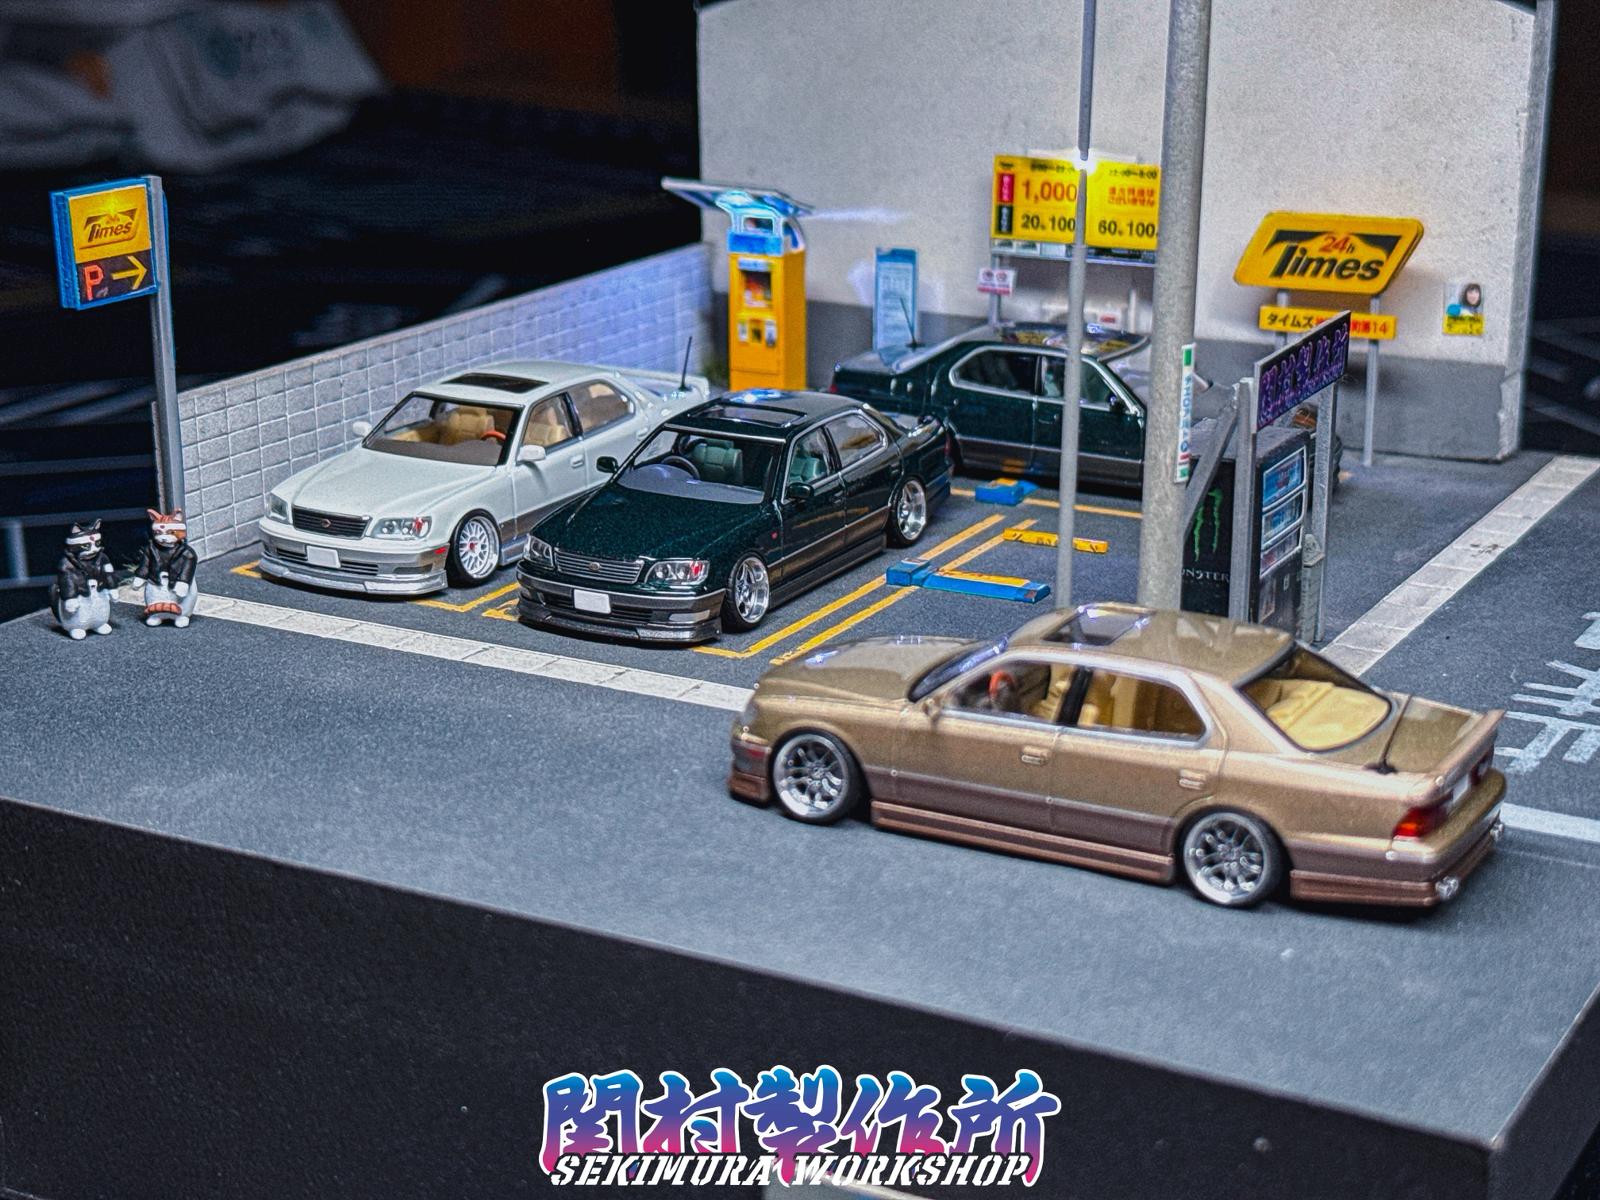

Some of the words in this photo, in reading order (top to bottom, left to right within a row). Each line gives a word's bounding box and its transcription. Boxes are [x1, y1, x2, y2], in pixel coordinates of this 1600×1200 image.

[84, 215, 133, 243] Times
[1319, 233, 1356, 254] 24h
[1267, 238, 1386, 281] Times
[84, 264, 104, 300] P
